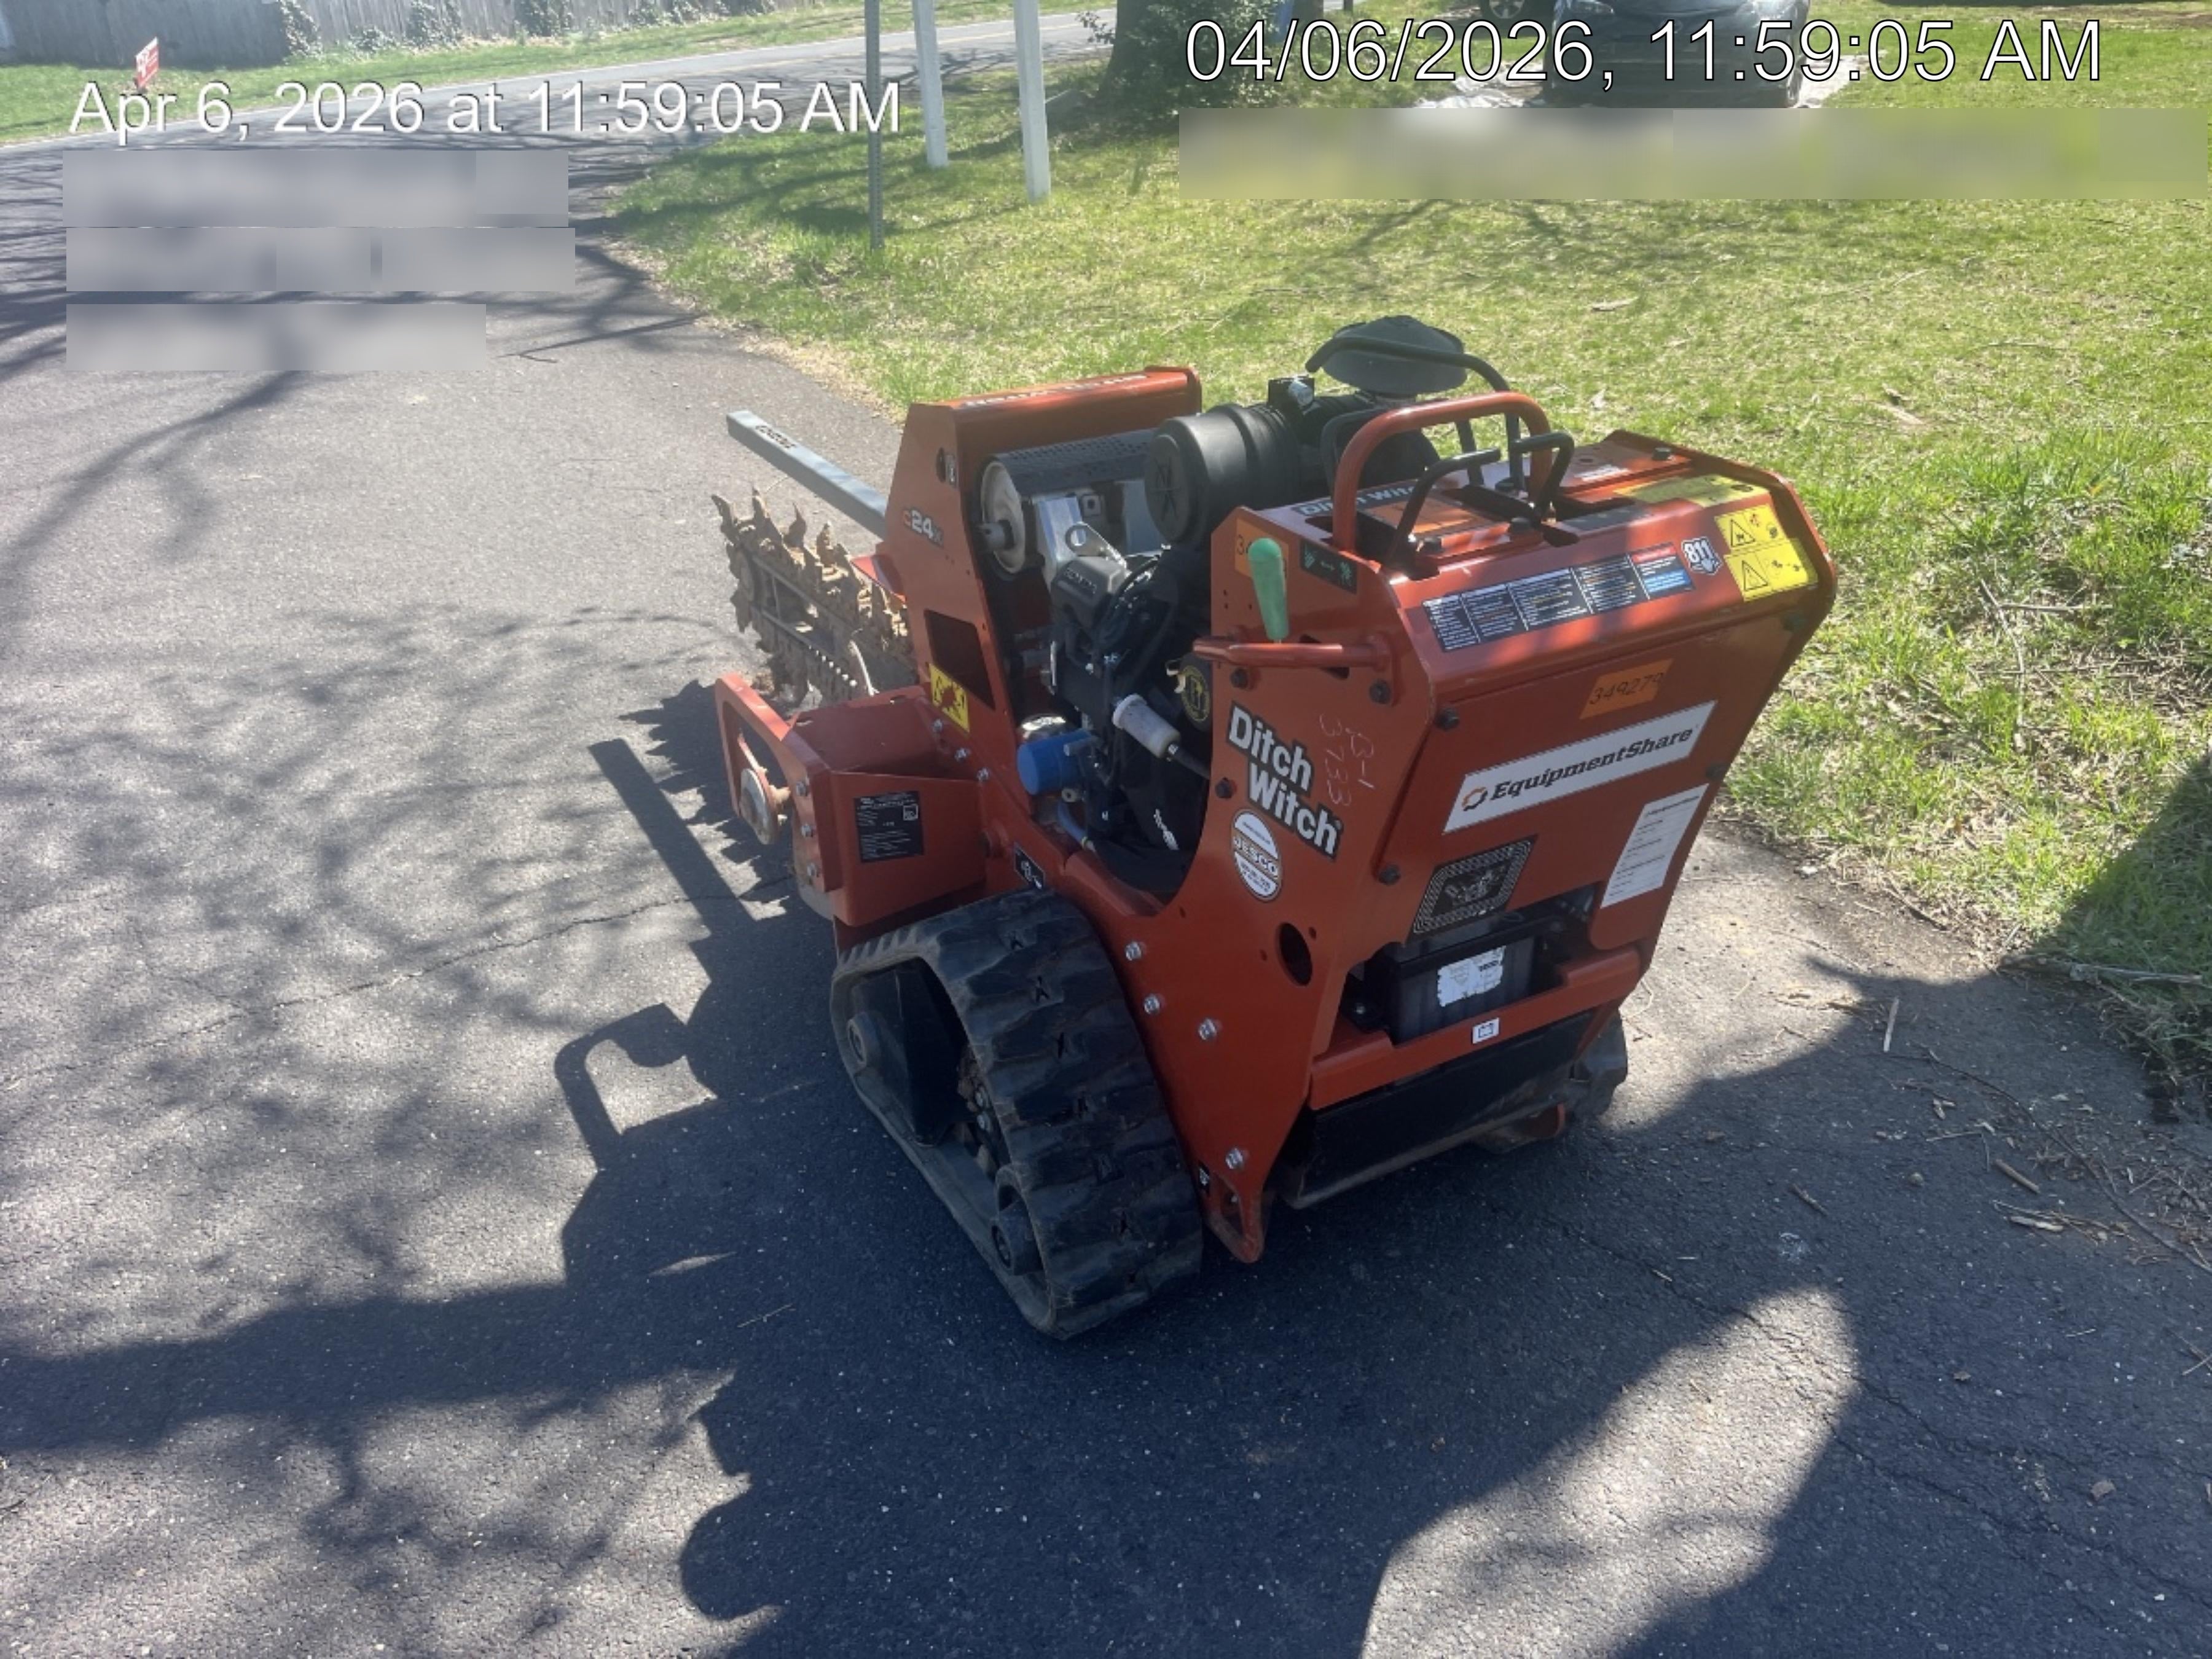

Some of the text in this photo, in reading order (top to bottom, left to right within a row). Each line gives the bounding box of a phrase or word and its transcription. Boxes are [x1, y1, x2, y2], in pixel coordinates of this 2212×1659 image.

[1685, 541, 1714, 563] 811
[1230, 706, 1312, 791] Ditch
[1490, 729, 1693, 799] EquipmentShare
[1249, 763, 1338, 855] Witch
